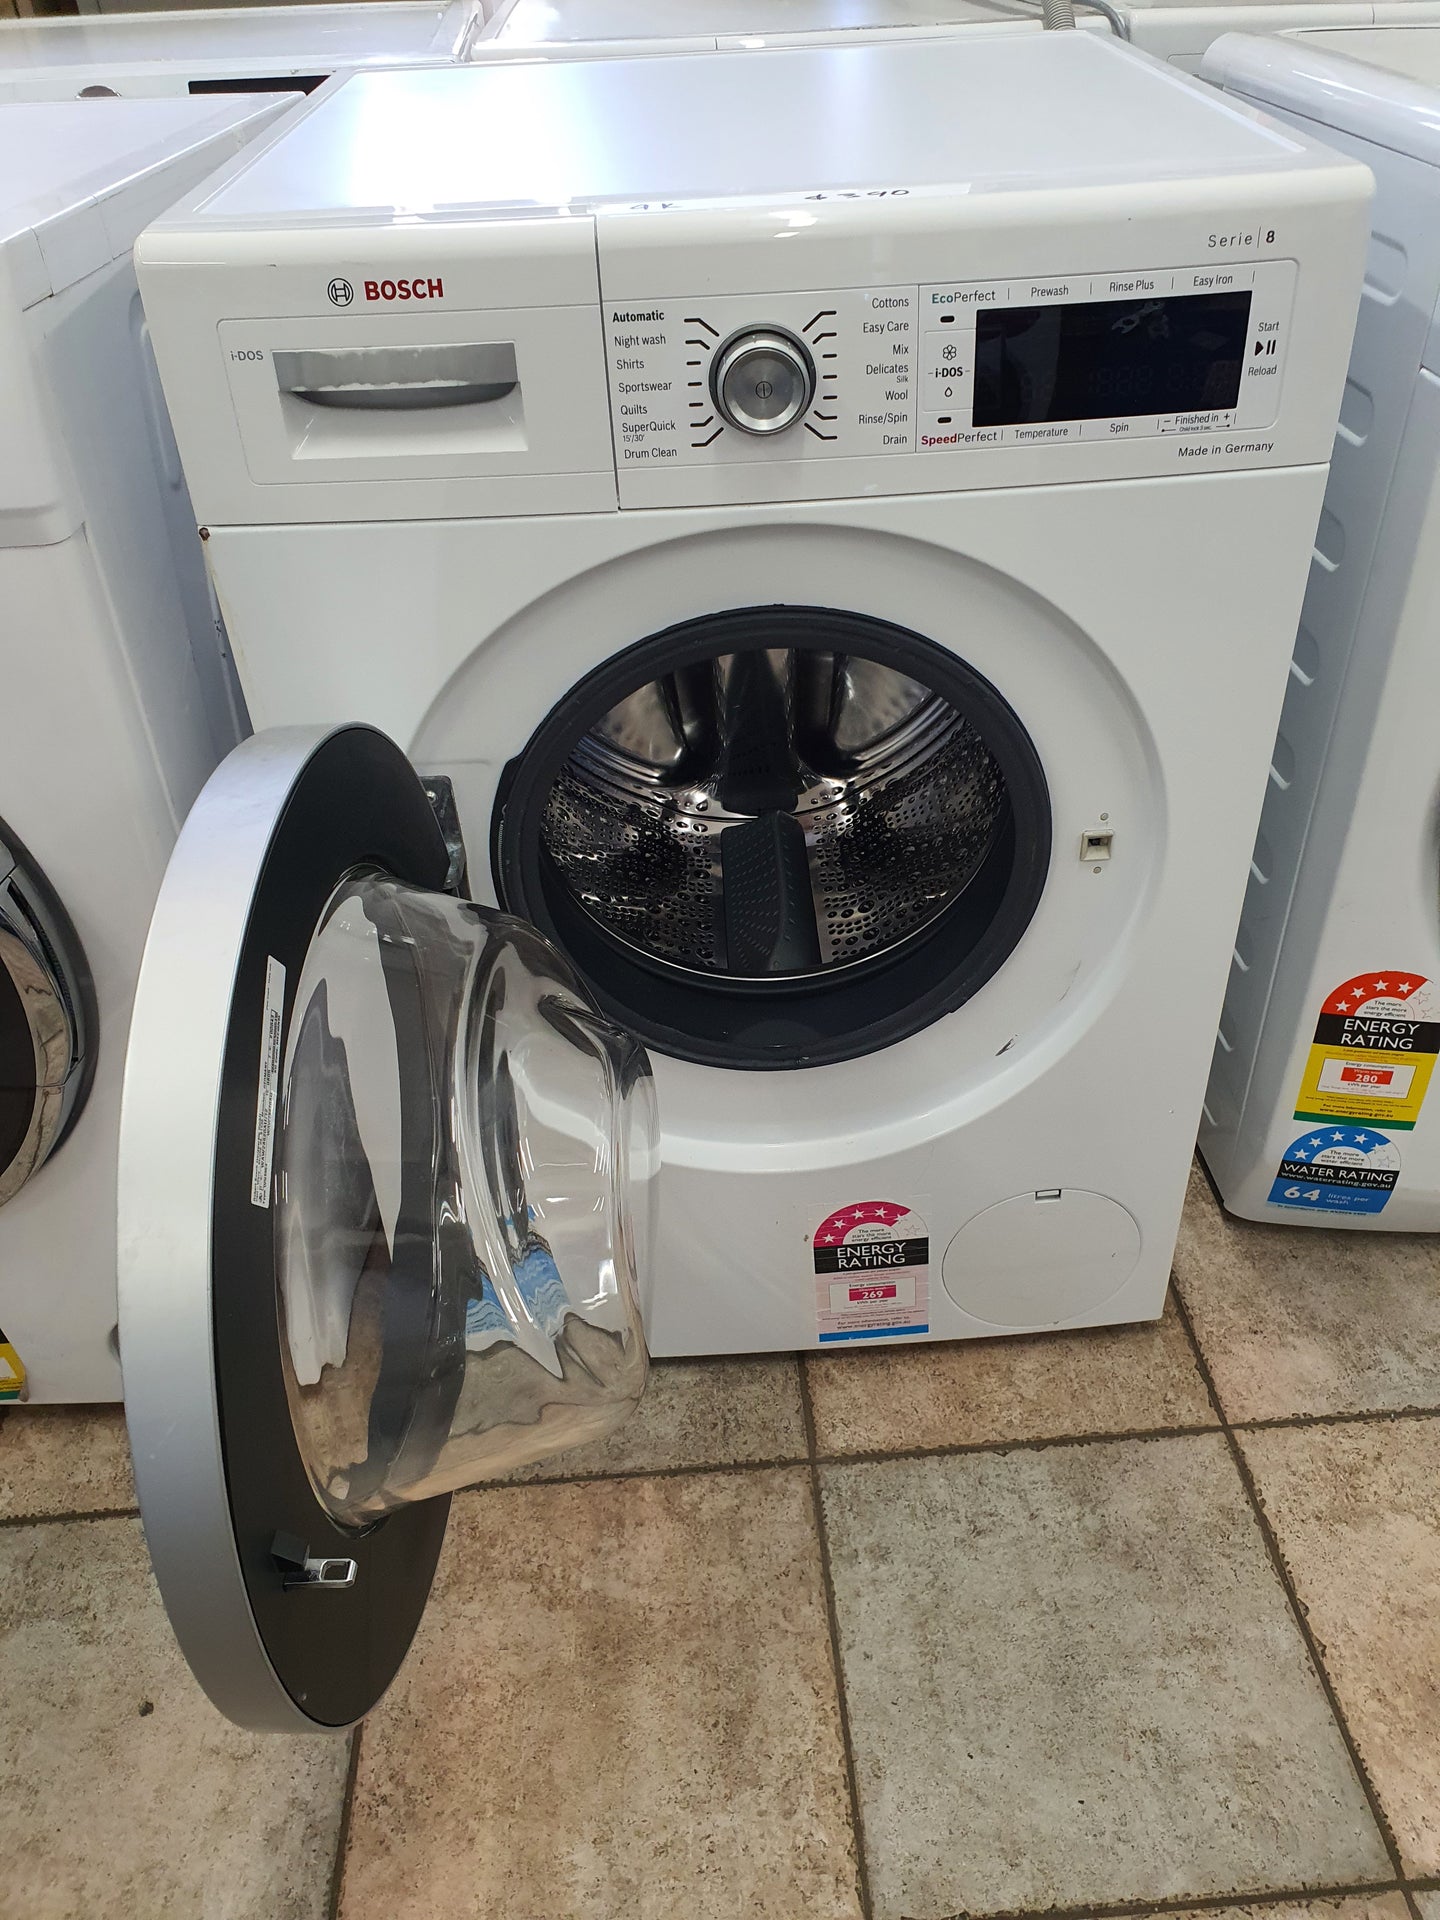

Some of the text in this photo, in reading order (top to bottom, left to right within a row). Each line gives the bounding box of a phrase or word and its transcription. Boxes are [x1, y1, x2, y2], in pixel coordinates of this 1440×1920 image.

[1208, 230, 1275, 248] Serie 8
[1110, 280, 1154, 292] Rinse Plus
[1193, 274, 1233, 288] Easy Iron
[364, 278, 443, 301] BOSCH
[1031, 285, 1069, 297] Prewash
[872, 297, 909, 309] Cottons
[932, 291, 996, 304] EcoPerfect
[613, 311, 665, 322] Automatic
[863, 321, 909, 334] Easy Care
[1258, 322, 1280, 332] Start
[614, 334, 666, 348] Night wash
[893, 344, 909, 355] Mix
[616, 360, 644, 369] Shirts
[866, 364, 908, 375] Delicates
[1248, 365, 1277, 377] Reload
[619, 381, 672, 394] Sportswear
[885, 389, 908, 400] Wool
[621, 405, 647, 415] Quilts
[859, 413, 908, 424] Rinse/Spin
[1175, 413, 1219, 425] Finished in
[622, 420, 676, 433] SuperQuick
[1110, 422, 1129, 433] Spin
[921, 432, 997, 446] SpeedPerfect
[1015, 426, 1069, 440] Temperature
[883, 434, 907, 445] Drain
[625, 448, 677, 459] Drum Clean
[1178, 442, 1274, 457] Made in Germany
[1344, 1019, 1420, 1035] ENERGY
[1341, 1033, 1413, 1050] RATING
[1355, 1074, 1378, 1083] 280
[1284, 1163, 1394, 1182] WATER RATING
[1284, 1186, 1321, 1201] 64
[837, 1242, 906, 1258] ENERGY
[838, 1254, 906, 1268] RATING
[862, 1290, 883, 1299] 269
